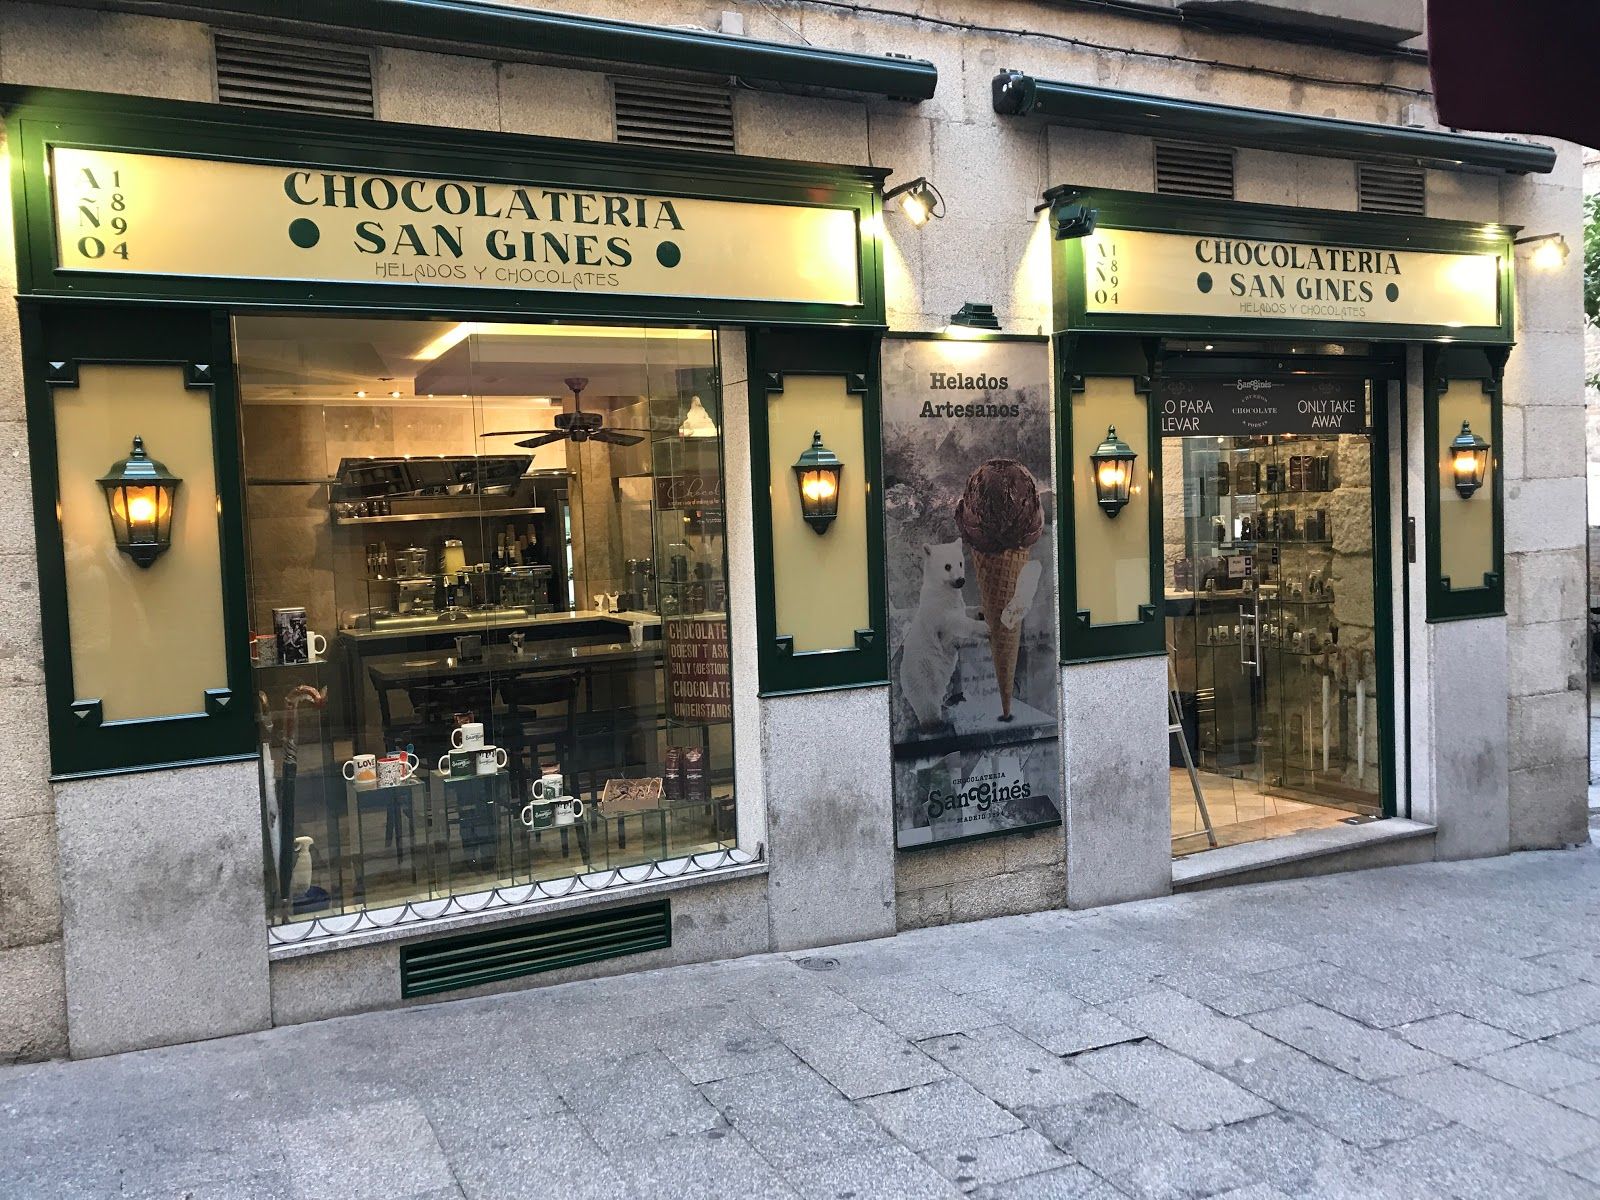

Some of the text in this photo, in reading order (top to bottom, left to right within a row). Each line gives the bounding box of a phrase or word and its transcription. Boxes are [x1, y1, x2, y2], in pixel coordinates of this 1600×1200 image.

[284, 171, 685, 231] CHOCOLATERIA
[111, 170, 129, 260] 1894
[353, 220, 633, 268] SAN GINES
[1195, 239, 1401, 275] CHOCOLATERIA
[375, 261, 619, 290] HELADOS Y CHOCOLATES
[1110, 244, 1118, 305] 1894
[1229, 272, 1374, 303] SAN GINES
[1239, 302, 1366, 319] HELADOS Y CHOCOLATES
[929, 372, 1009, 390] Helados
[919, 400, 1020, 418] Artesanos
[1180, 400, 1214, 414] PARA
[1232, 406, 1278, 415] CHOCOLATE
[1297, 400, 1356, 414] ONLY TAKE
[1311, 415, 1343, 428] AWAY
[669, 623, 728, 640] CHOCOLATE
[711, 643, 729, 659] ASK
[671, 662, 691, 675] SILLY
[673, 680, 731, 698] CHOCOLATE
[674, 702, 732, 718] UNDERSTANDS
[952, 772, 1007, 785] CHOCOLATERIA
[956, 814, 986, 824] MADRID
